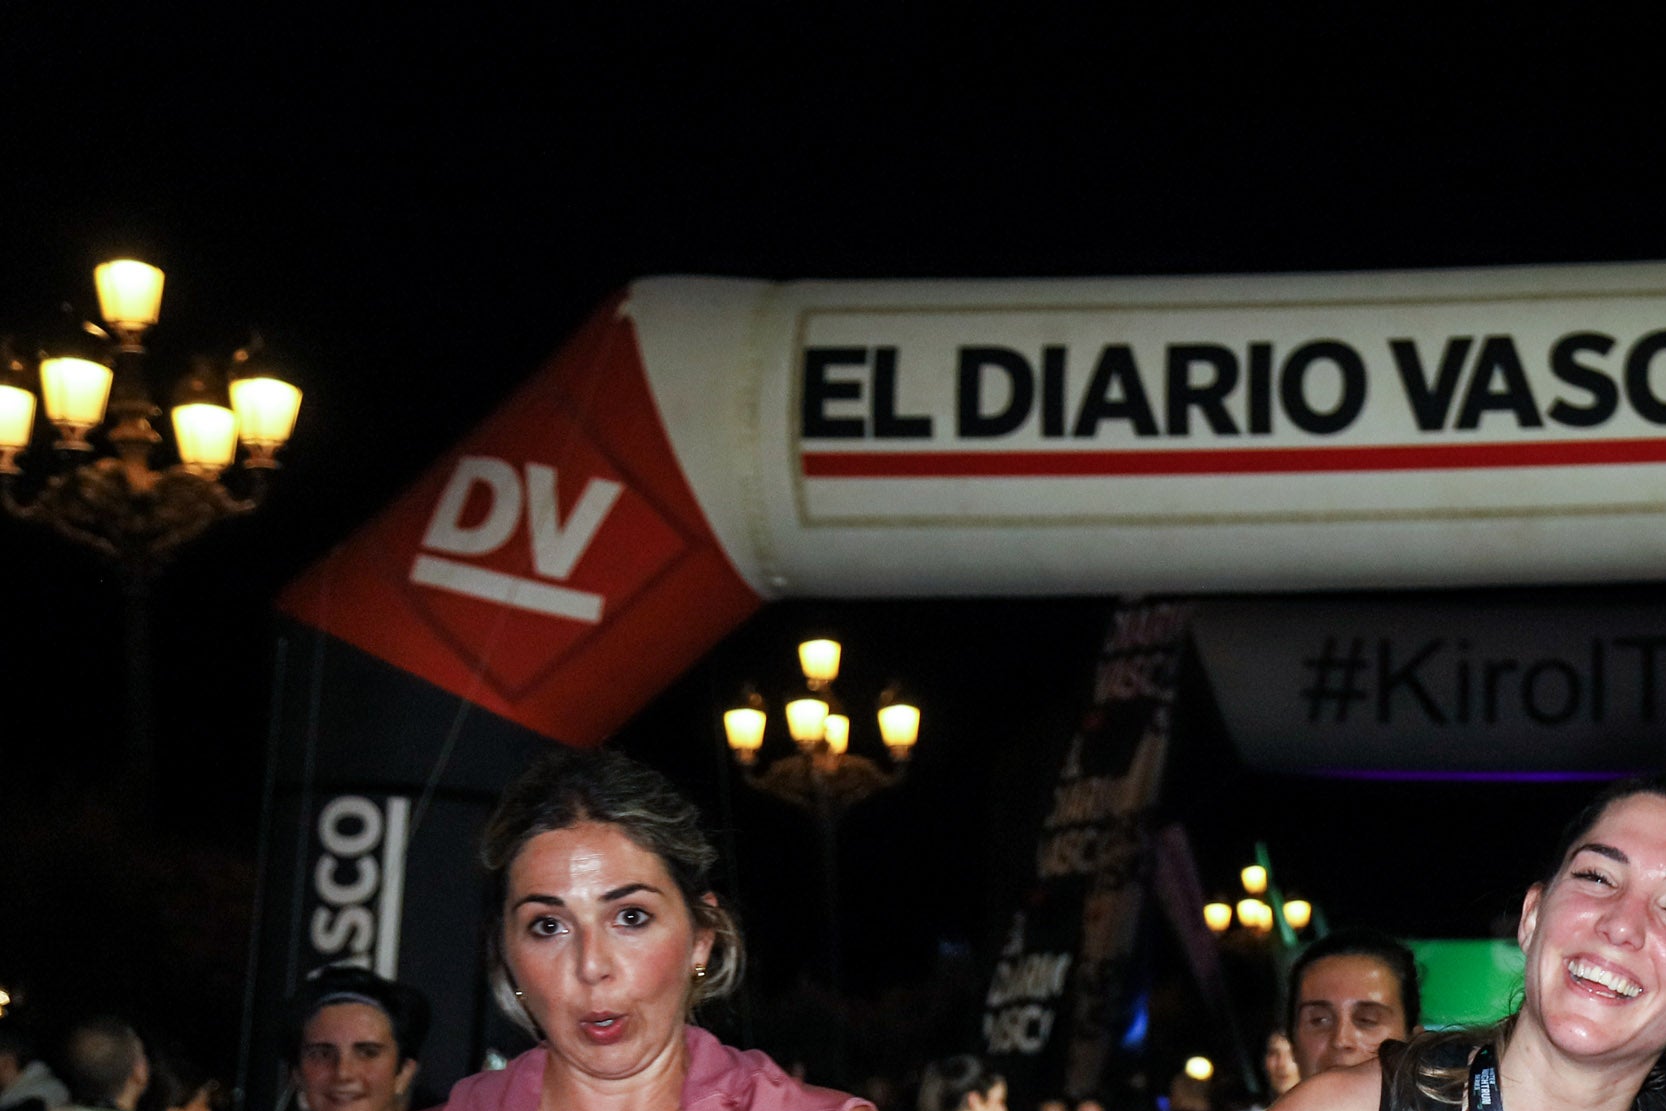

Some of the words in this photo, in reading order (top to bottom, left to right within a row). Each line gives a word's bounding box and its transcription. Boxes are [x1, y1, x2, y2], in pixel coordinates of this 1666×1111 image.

[802, 346, 932, 440] EL
[957, 339, 1368, 439] DIARIO
[421, 455, 626, 581] DV
[308, 795, 383, 977] SCO
